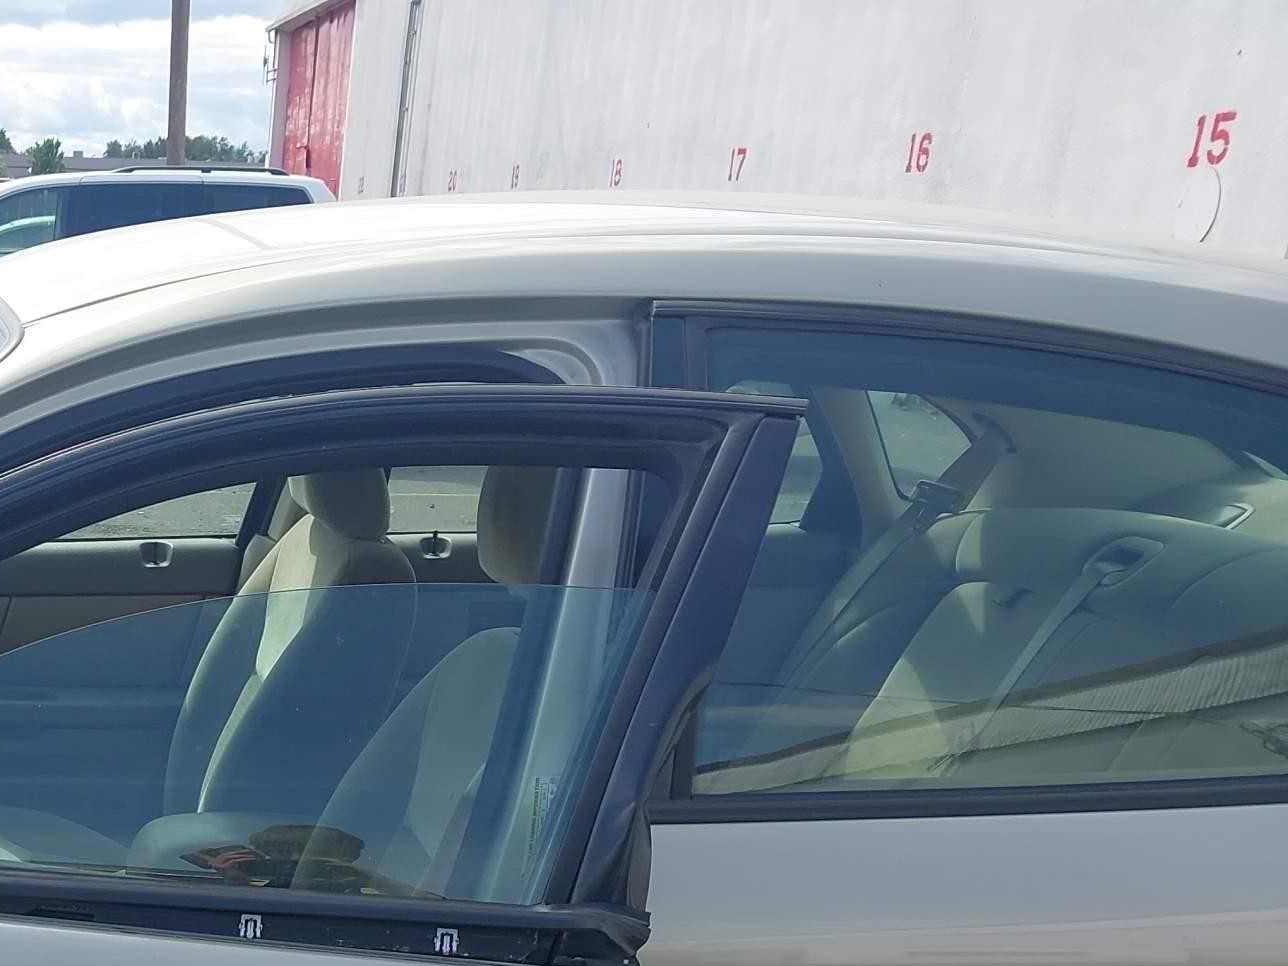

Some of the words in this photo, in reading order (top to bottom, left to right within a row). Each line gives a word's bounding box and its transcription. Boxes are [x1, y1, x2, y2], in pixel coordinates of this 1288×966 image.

[905, 132, 932, 173] 16
[1186, 111, 1237, 168] 15
[447, 170, 458, 192] 20
[609, 159, 623, 187] 18
[727, 148, 747, 181] 17
